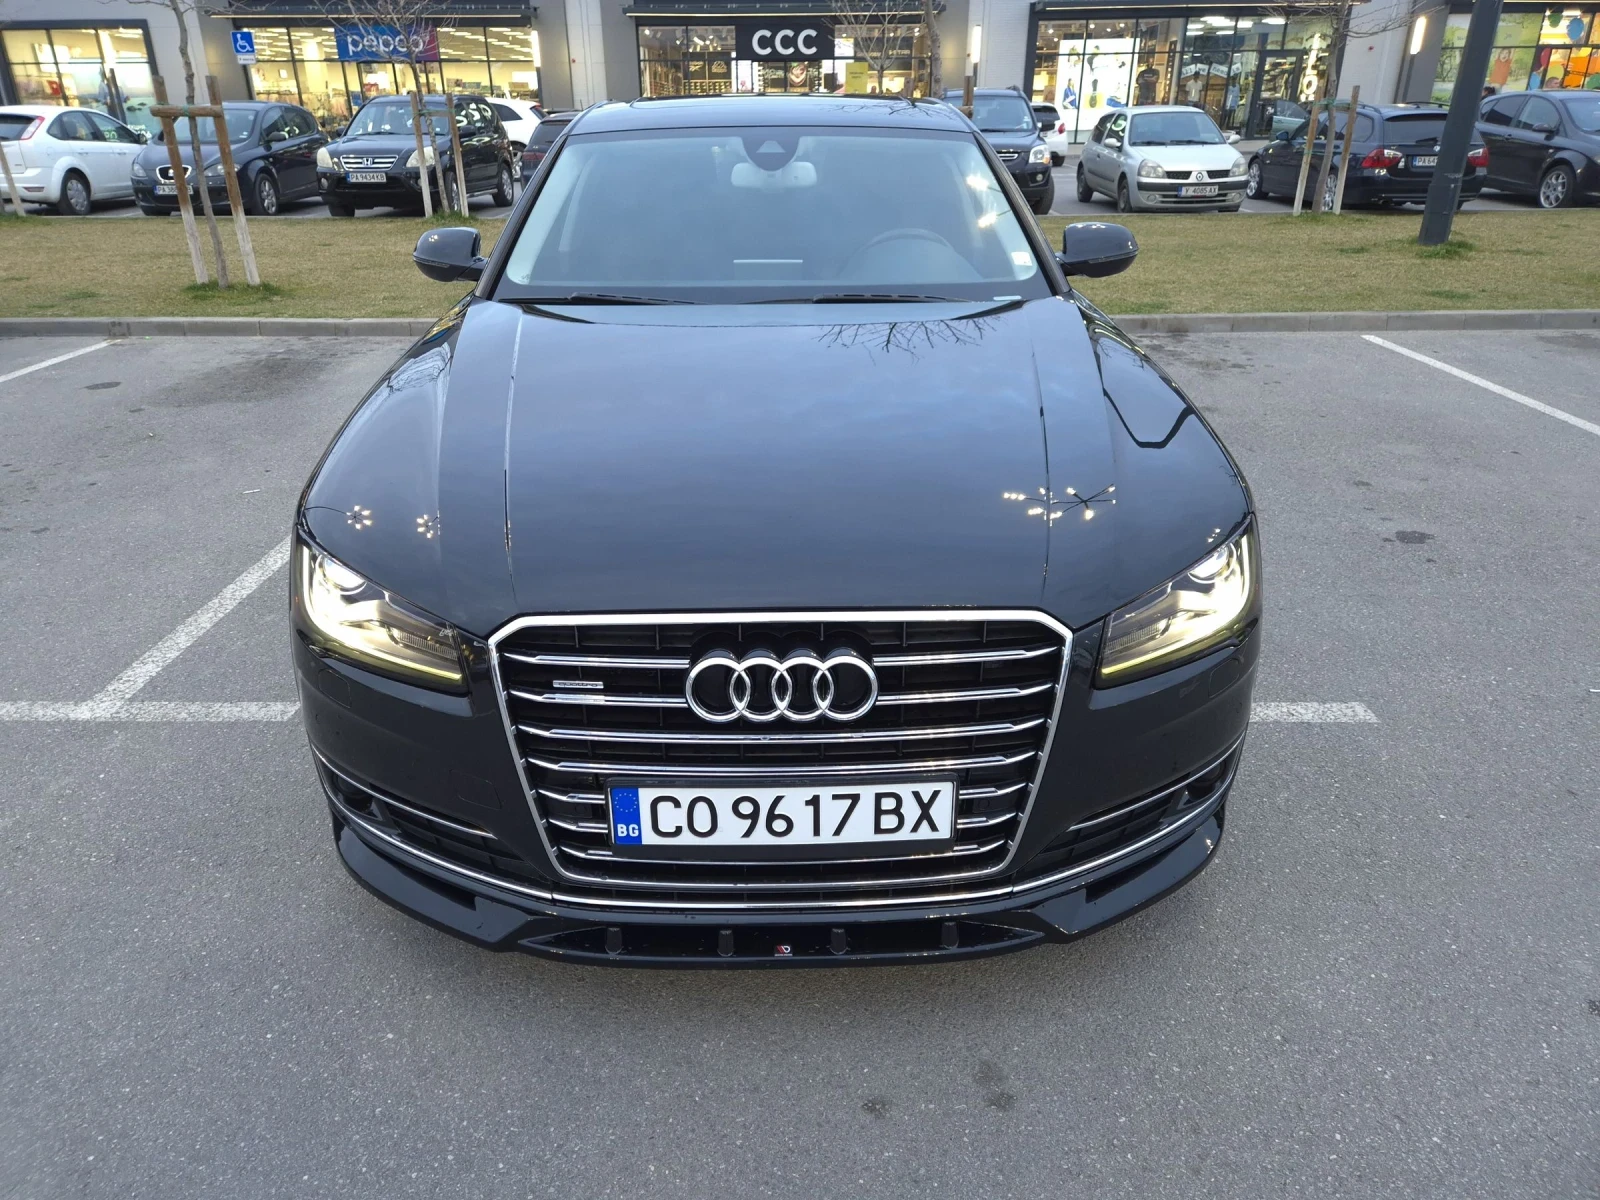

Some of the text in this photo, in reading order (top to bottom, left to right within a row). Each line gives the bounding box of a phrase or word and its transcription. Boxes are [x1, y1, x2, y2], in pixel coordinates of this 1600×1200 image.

[347, 35, 424, 56] pepco
[752, 28, 818, 55] CCC
[650, 790, 943, 838] CO 9617 BX
[617, 823, 639, 837] BG
